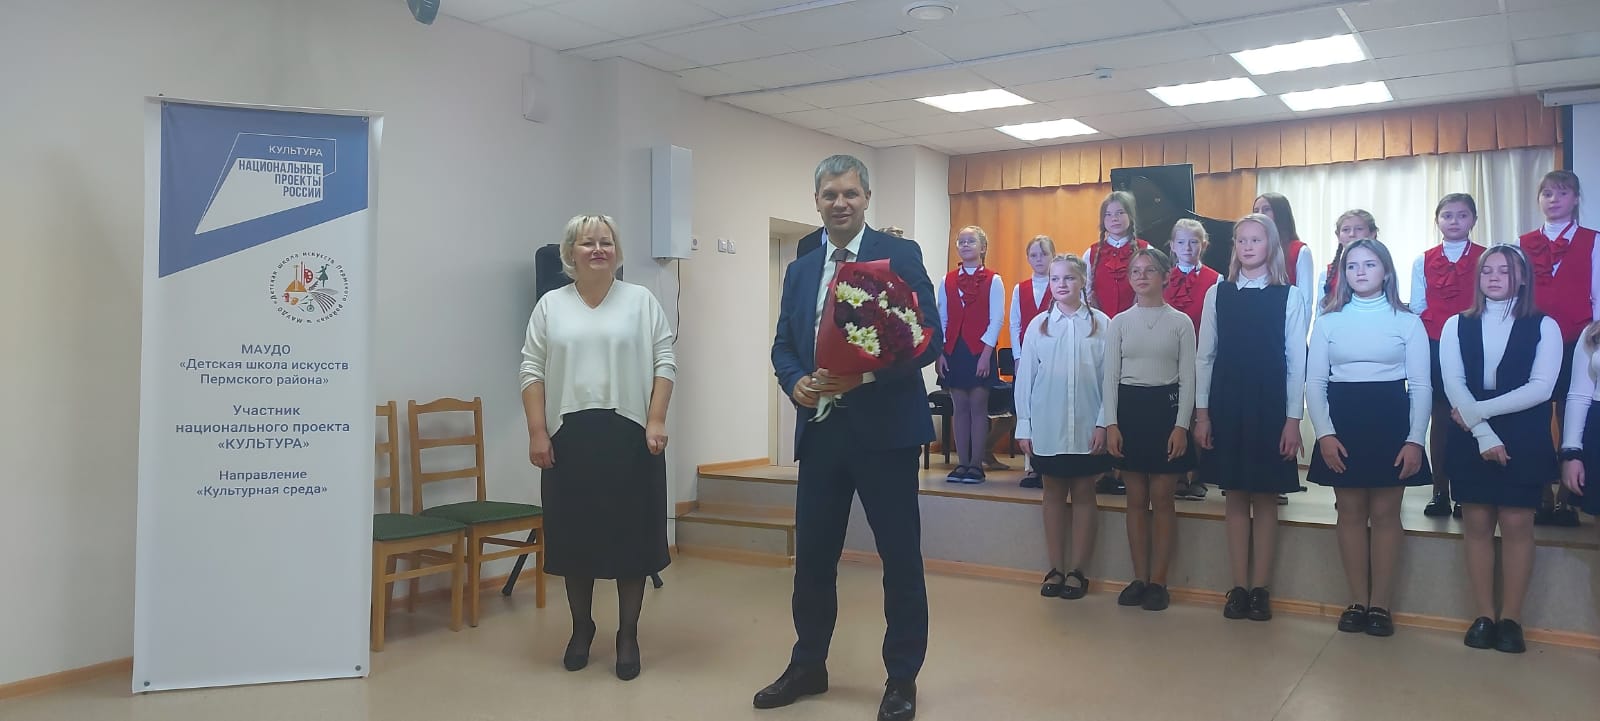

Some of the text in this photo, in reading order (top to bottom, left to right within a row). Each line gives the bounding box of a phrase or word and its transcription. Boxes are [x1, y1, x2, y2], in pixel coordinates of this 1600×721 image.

[269, 145, 323, 157] КУЛЬТУРА
[238, 159, 321, 175] НАЦИОНАЛЬНЫЕ
[274, 174, 321, 187] ПРОЕКТЫ
[283, 186, 321, 198] РОССИИ
[278, 253, 299, 269] школа
[302, 252, 335, 264] искусств
[241, 344, 291, 356] МАУДО
[179, 358, 349, 373] «Детская школа искусств
[200, 374, 329, 387] Пермского района»
[233, 404, 301, 416] Участник
[175, 422, 350, 435] национального проекта
[218, 438, 310, 450] «КУЛЬТУРА»
[219, 470, 307, 482] Направление
[196, 484, 328, 498] «Культурная среда»
